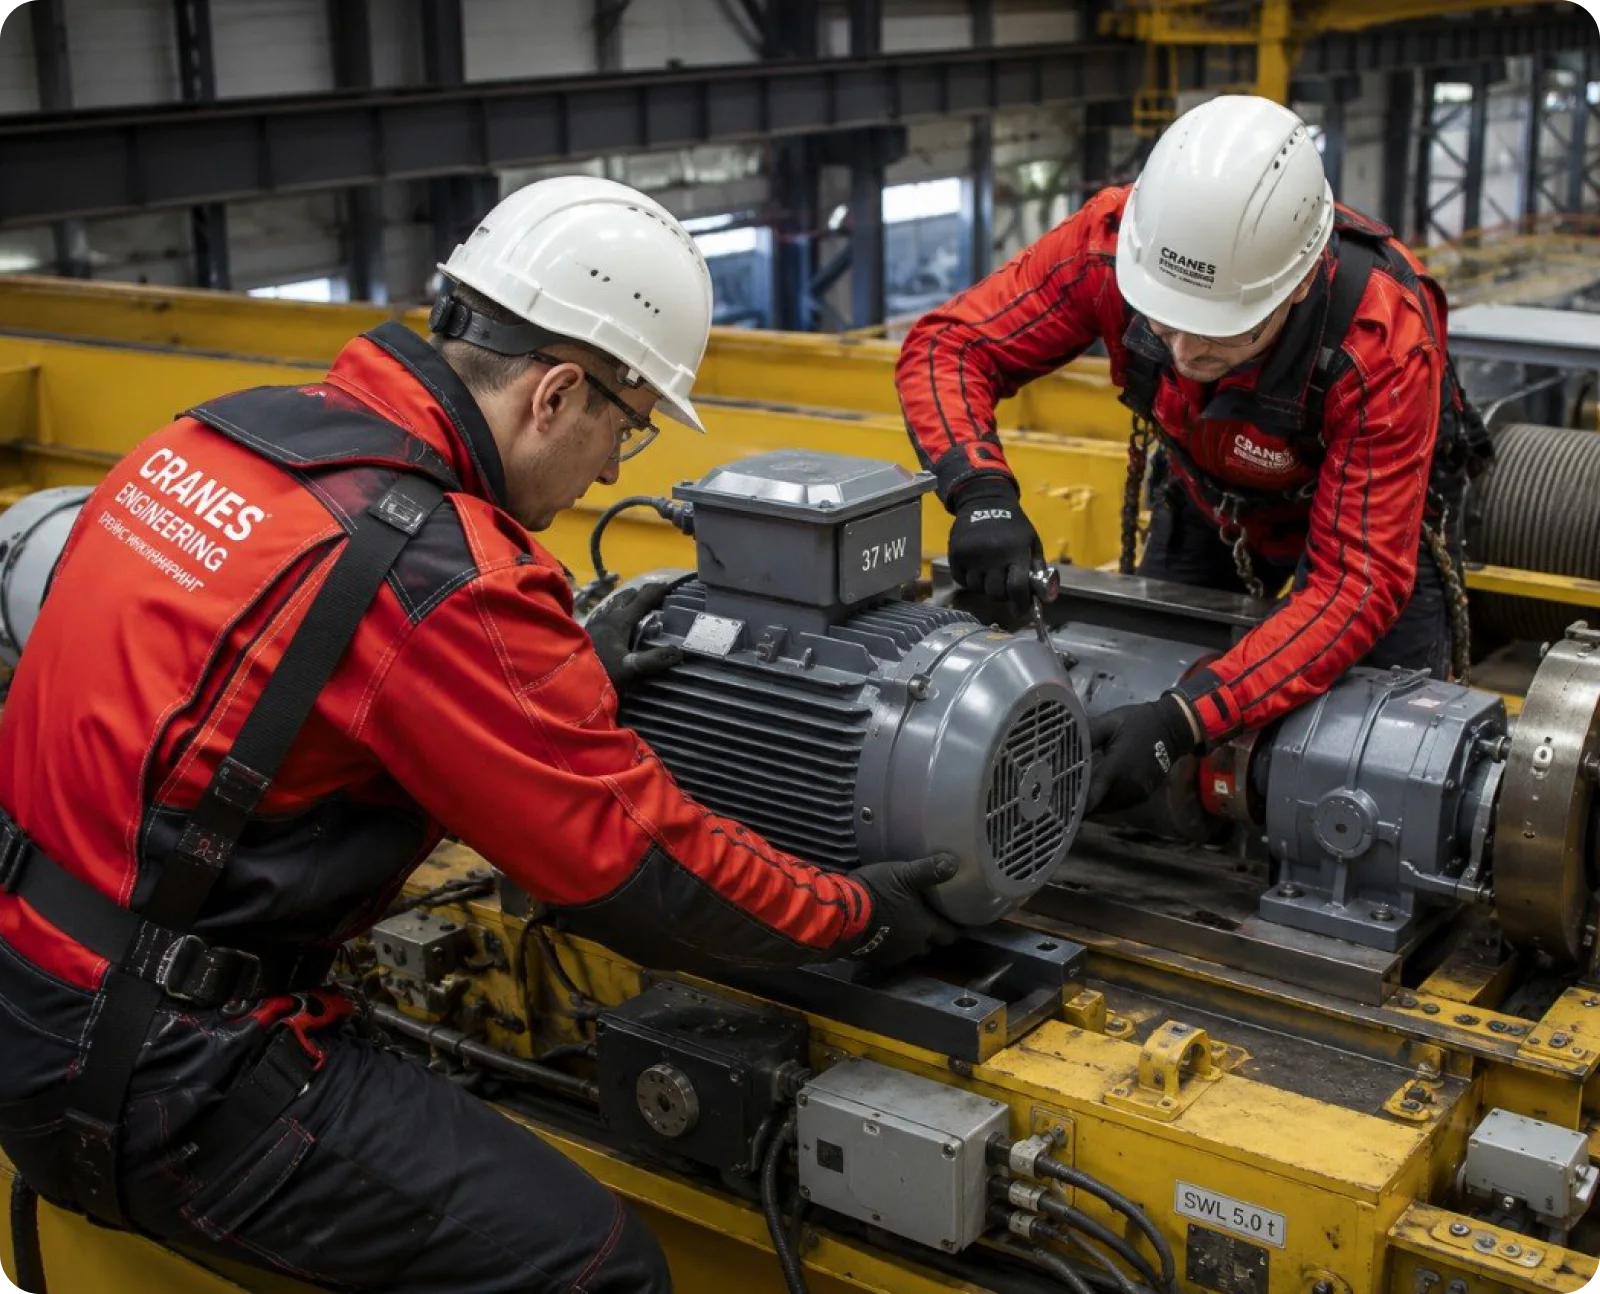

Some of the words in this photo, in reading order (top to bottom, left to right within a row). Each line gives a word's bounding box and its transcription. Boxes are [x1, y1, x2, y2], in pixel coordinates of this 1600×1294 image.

[1161, 247, 1216, 275] CRANES
[139, 448, 265, 541] CRANES
[115, 482, 228, 572] ENGINEERING
[862, 545, 879, 571] 37
[884, 536, 906, 564] kW
[1184, 1192, 1227, 1221] SWL
[1233, 1207, 1262, 1232] 5.0
[1267, 1219, 1275, 1237] t
